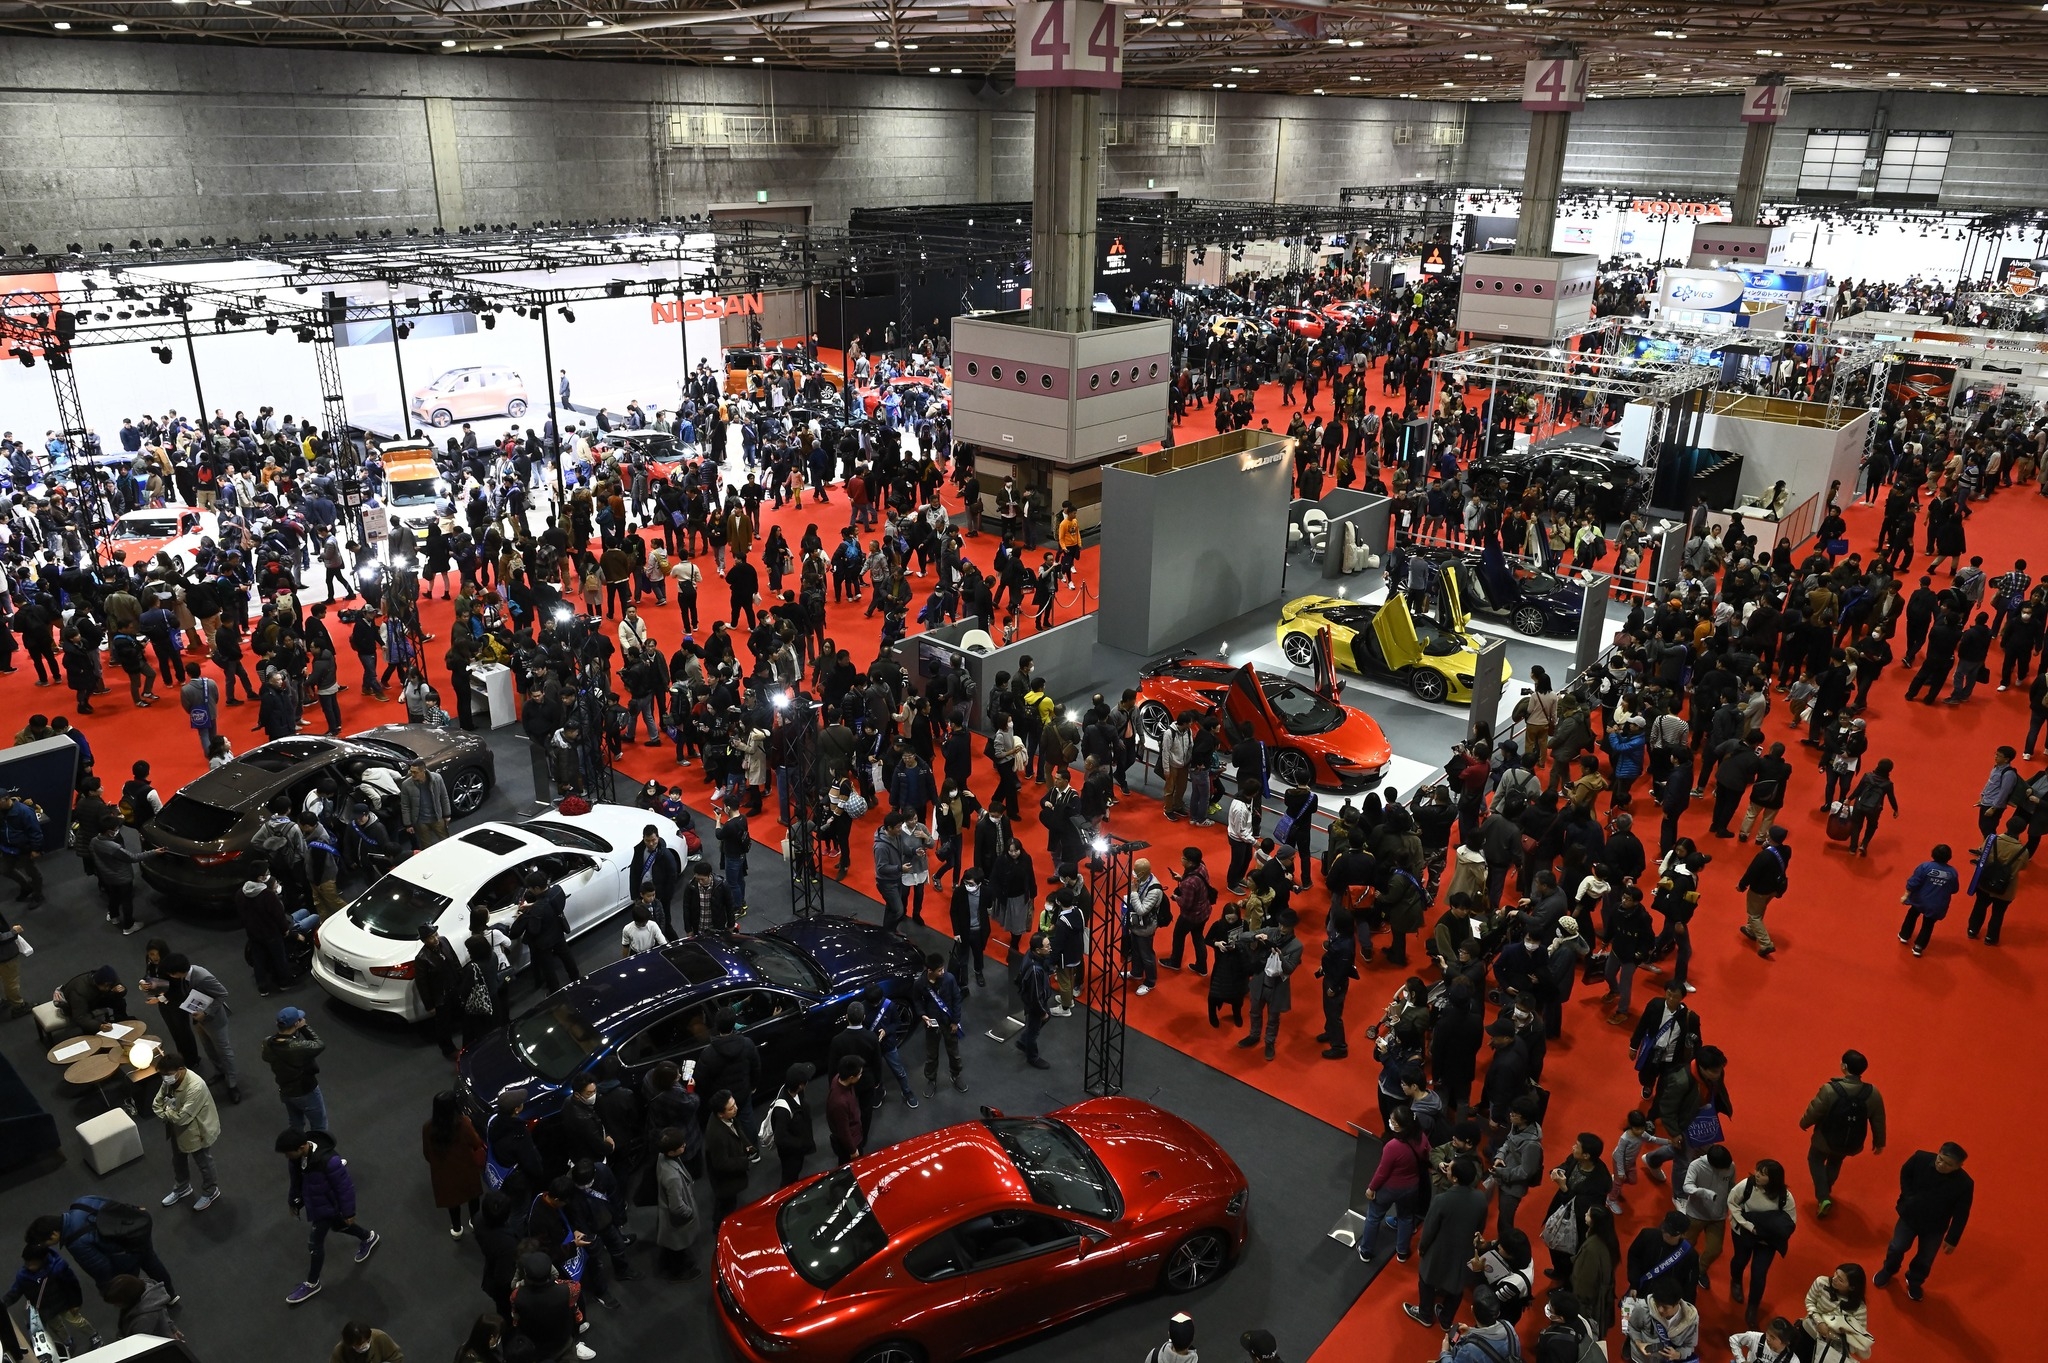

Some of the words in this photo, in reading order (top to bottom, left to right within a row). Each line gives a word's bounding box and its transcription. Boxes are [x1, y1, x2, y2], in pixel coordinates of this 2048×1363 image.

[1031, 0, 1070, 71] 4
[1088, 4, 1119, 72] 4
[1535, 59, 1566, 101] 4
[1574, 60, 1588, 102] 4
[1752, 85, 1776, 115] 4
[1632, 200, 1723, 216] HONDA
[651, 292, 764, 324] NISSAN
